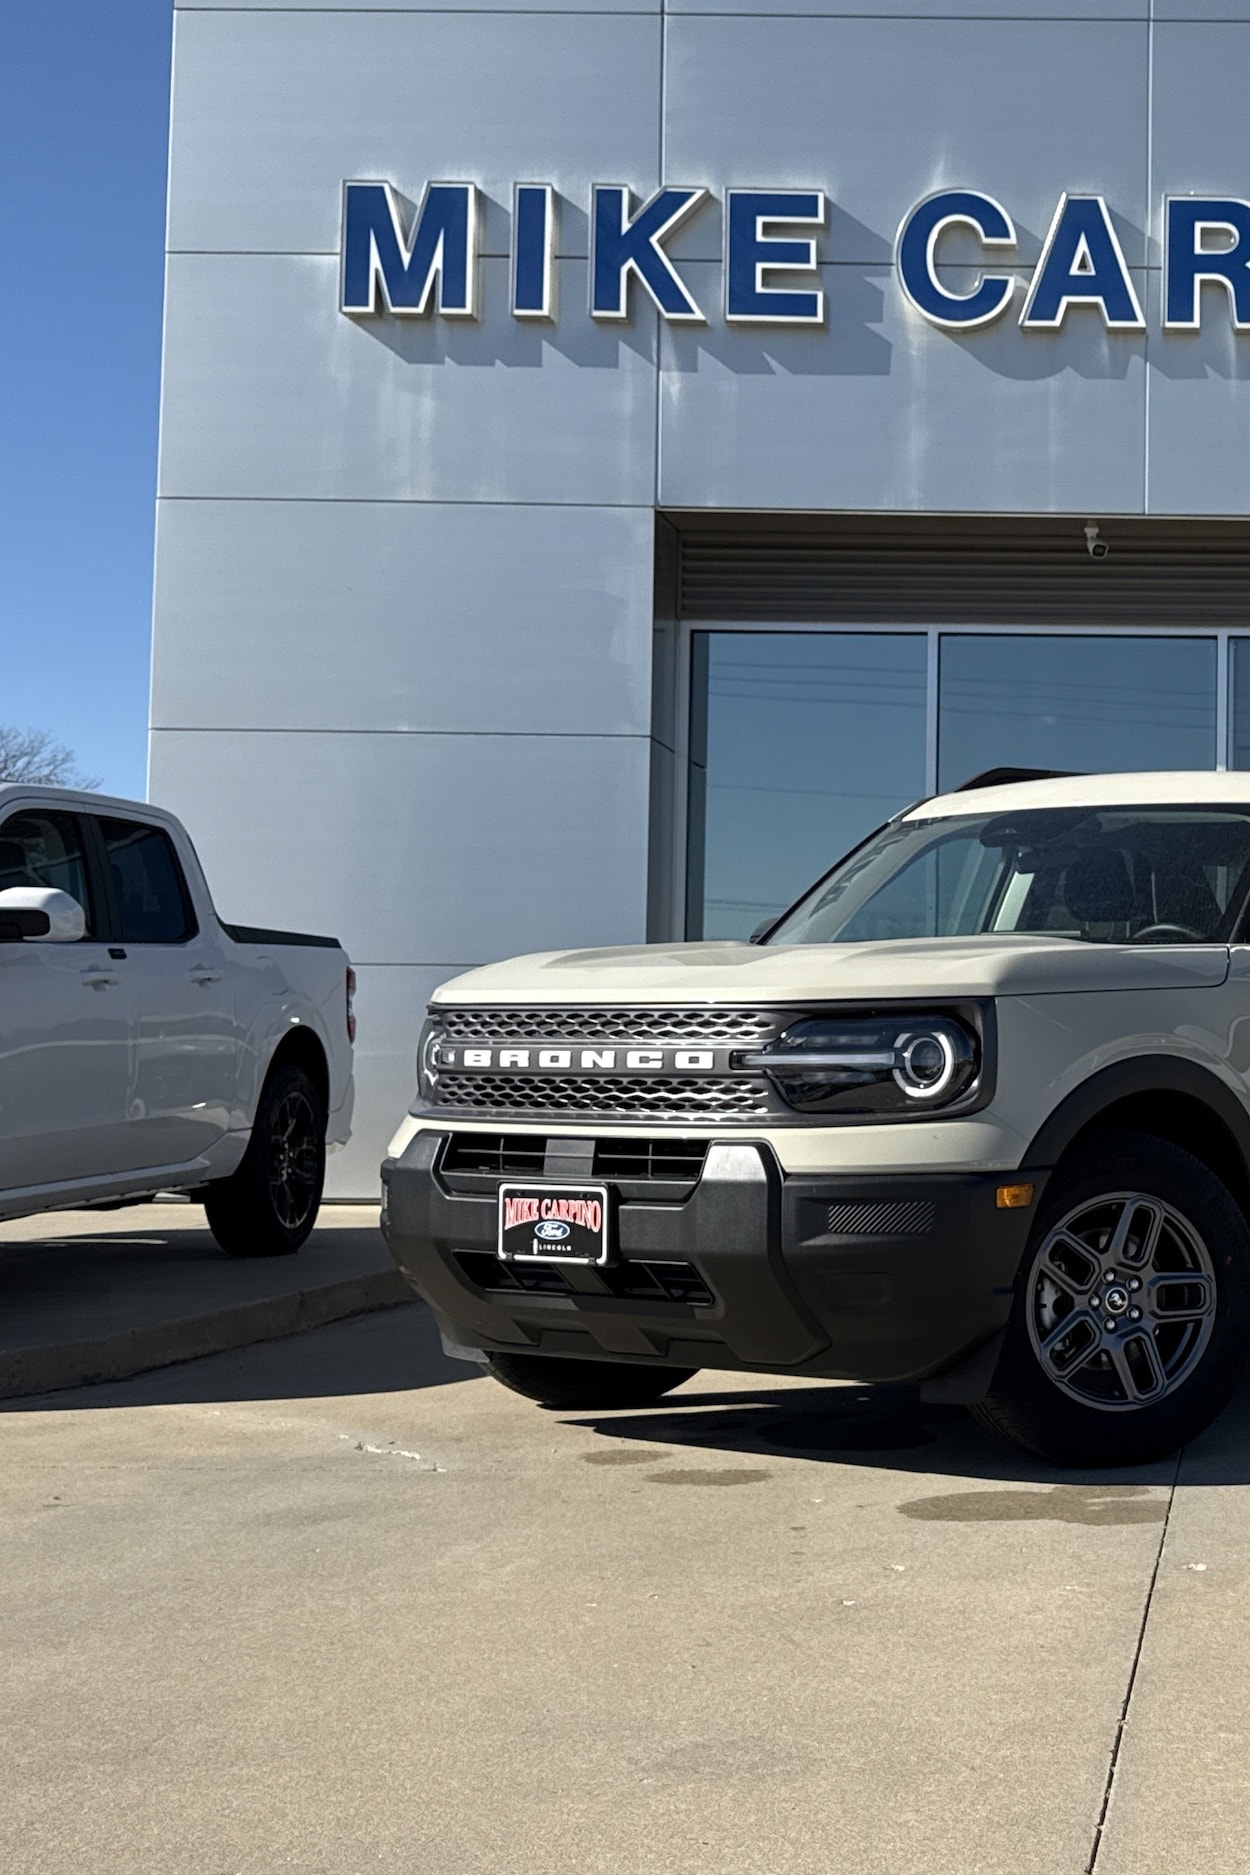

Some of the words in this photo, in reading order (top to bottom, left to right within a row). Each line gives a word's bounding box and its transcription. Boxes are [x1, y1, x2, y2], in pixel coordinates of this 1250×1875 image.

[340, 180, 825, 326] MIKE
[464, 1049, 714, 1069] BRONCO
[504, 1198, 539, 1231] MIKE
[541, 1198, 601, 1233] CARPINO
